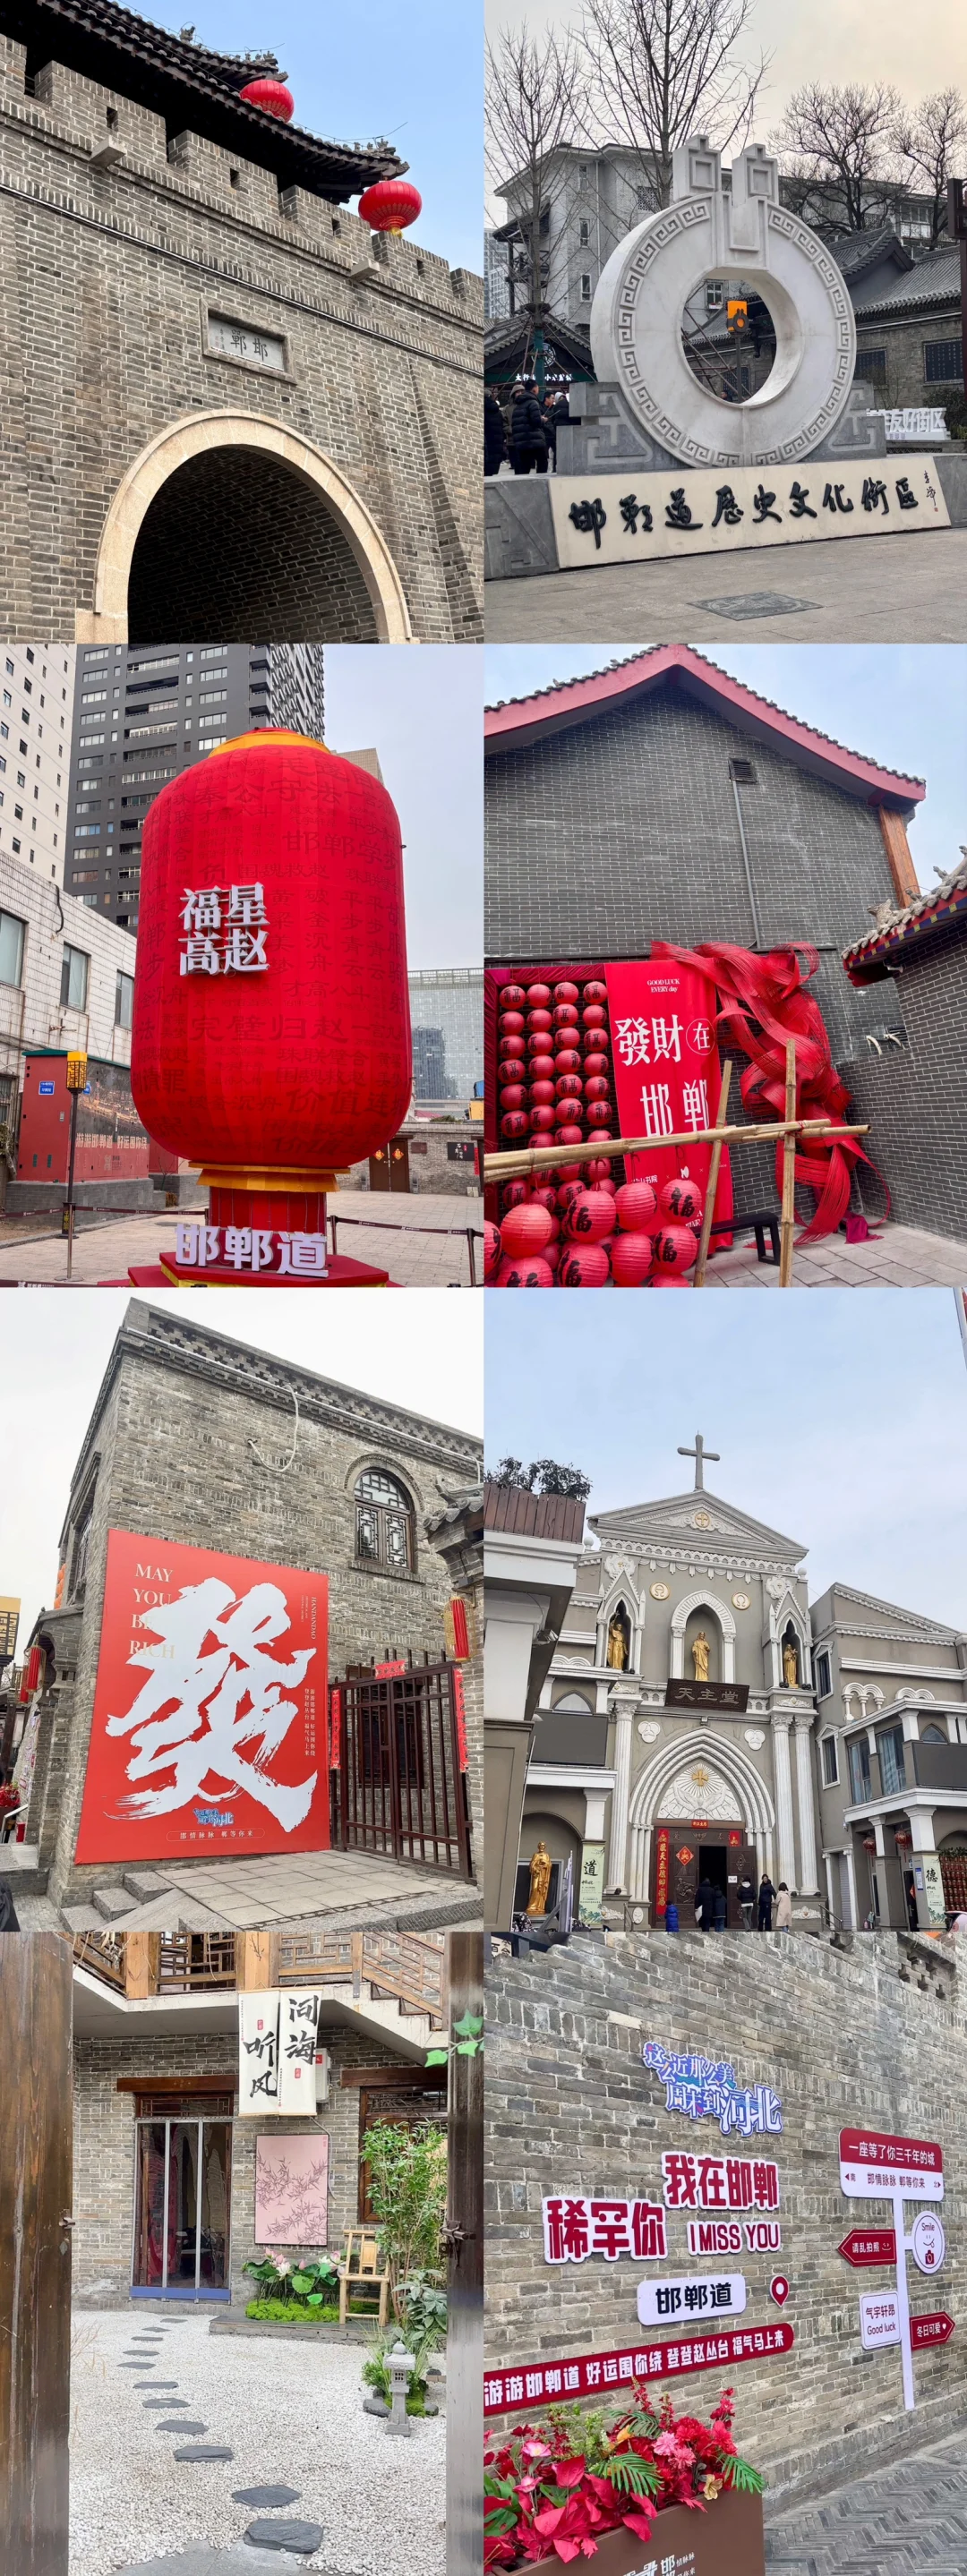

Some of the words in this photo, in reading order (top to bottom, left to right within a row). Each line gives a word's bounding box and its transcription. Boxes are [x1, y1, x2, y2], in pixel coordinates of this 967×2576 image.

[178, 882, 270, 931] 福星
[178, 928, 270, 977] 高赵
[190, 1014, 349, 1045] 完璧归赵
[614, 1014, 684, 1067] 發財
[692, 1022, 710, 1051] 在
[639, 1079, 710, 1138] 邯郸
[668, 1187, 696, 1217] 福
[175, 1224, 329, 1278] 邯郸道
[134, 1563, 174, 1583] MAY
[133, 1588, 173, 1608] YOU
[131, 1614, 154, 1630] BE
[128, 1640, 176, 1659] RICH
[675, 1687, 740, 1705] 天主堂
[583, 1859, 598, 1877] 道
[926, 1868, 938, 1882] 德
[646, 2043, 734, 2086] 这么近那么美
[667, 2084, 783, 2137] 周末到河北
[849, 2141, 936, 2166] 一座等了你三千年的城
[665, 2154, 777, 2207] 我在邯郸
[867, 2172, 896, 2187] 邯情脉脉
[899, 2175, 926, 2189] 郸等你来
[547, 2199, 666, 2260] 稀罕你
[690, 2224, 696, 2252] I
[699, 2223, 740, 2251] MISS
[746, 2223, 780, 2249] YOU
[921, 2222, 936, 2231] Smile
[852, 2241, 880, 2254] 请乱拍照
[655, 2282, 732, 2315] 邯郸道
[865, 2304, 895, 2320] 气宇轩昂
[867, 2324, 884, 2335] Good
[885, 2323, 896, 2333] luck
[916, 2322, 942, 2338] 冬日可爱
[484, 2366, 580, 2407] 游游邯郸道
[586, 2350, 663, 2385] 好运围你绕
[666, 2339, 729, 2369] 登登赵丛台
[732, 2329, 784, 2355] 福气马上来
